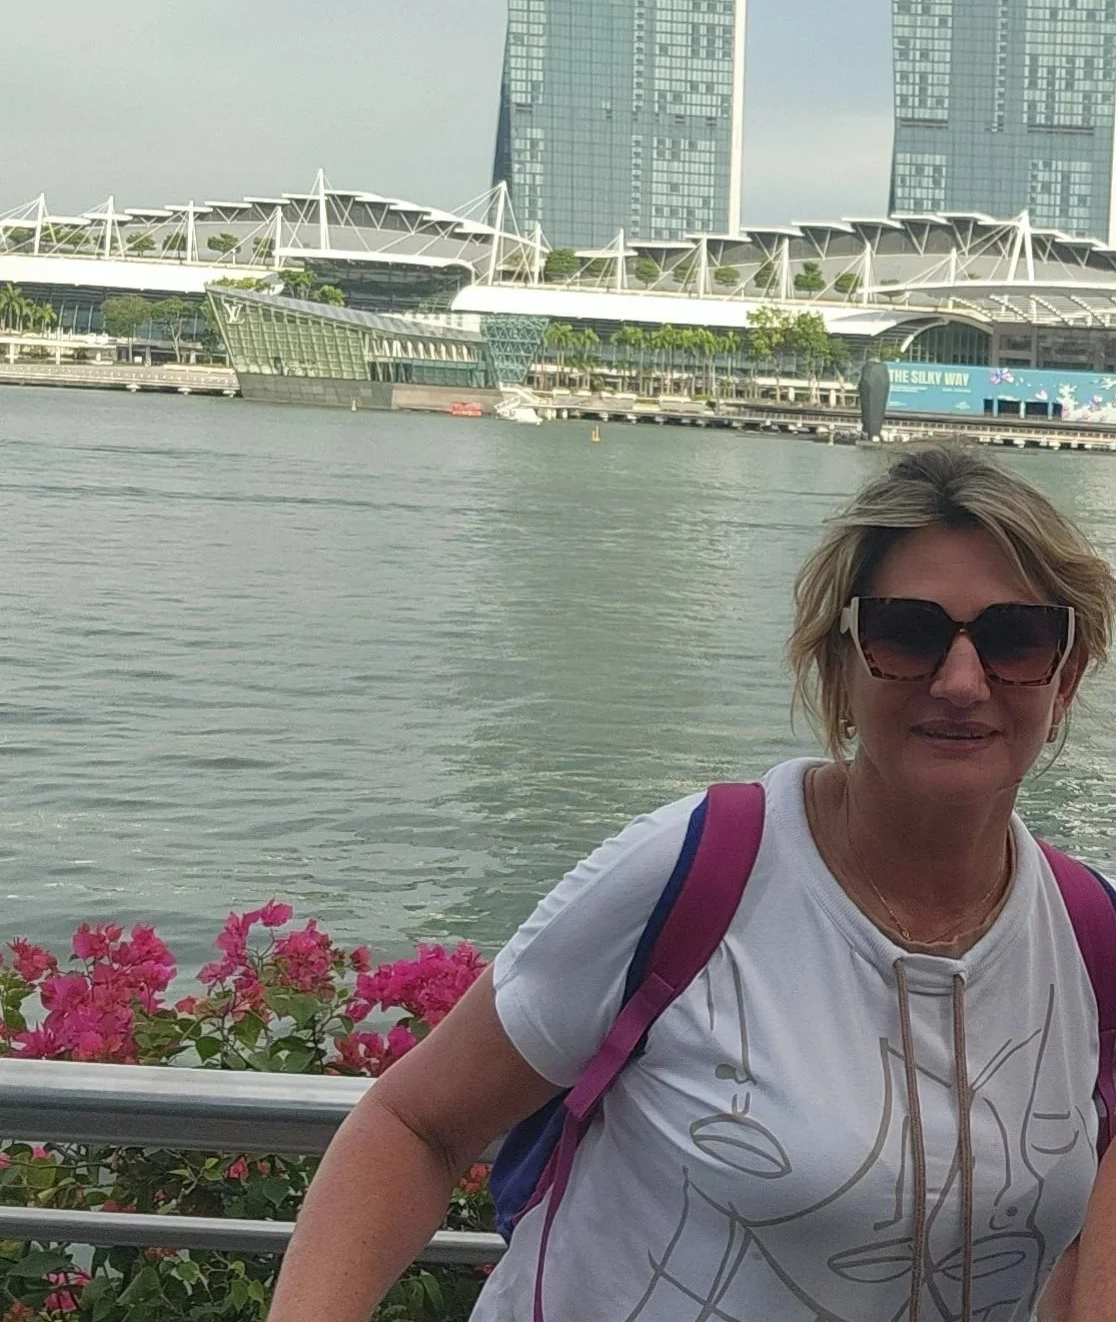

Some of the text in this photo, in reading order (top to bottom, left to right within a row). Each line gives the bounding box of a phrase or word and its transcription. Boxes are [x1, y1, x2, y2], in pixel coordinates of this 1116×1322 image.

[888, 369, 970, 387] THE SILKY WAY
